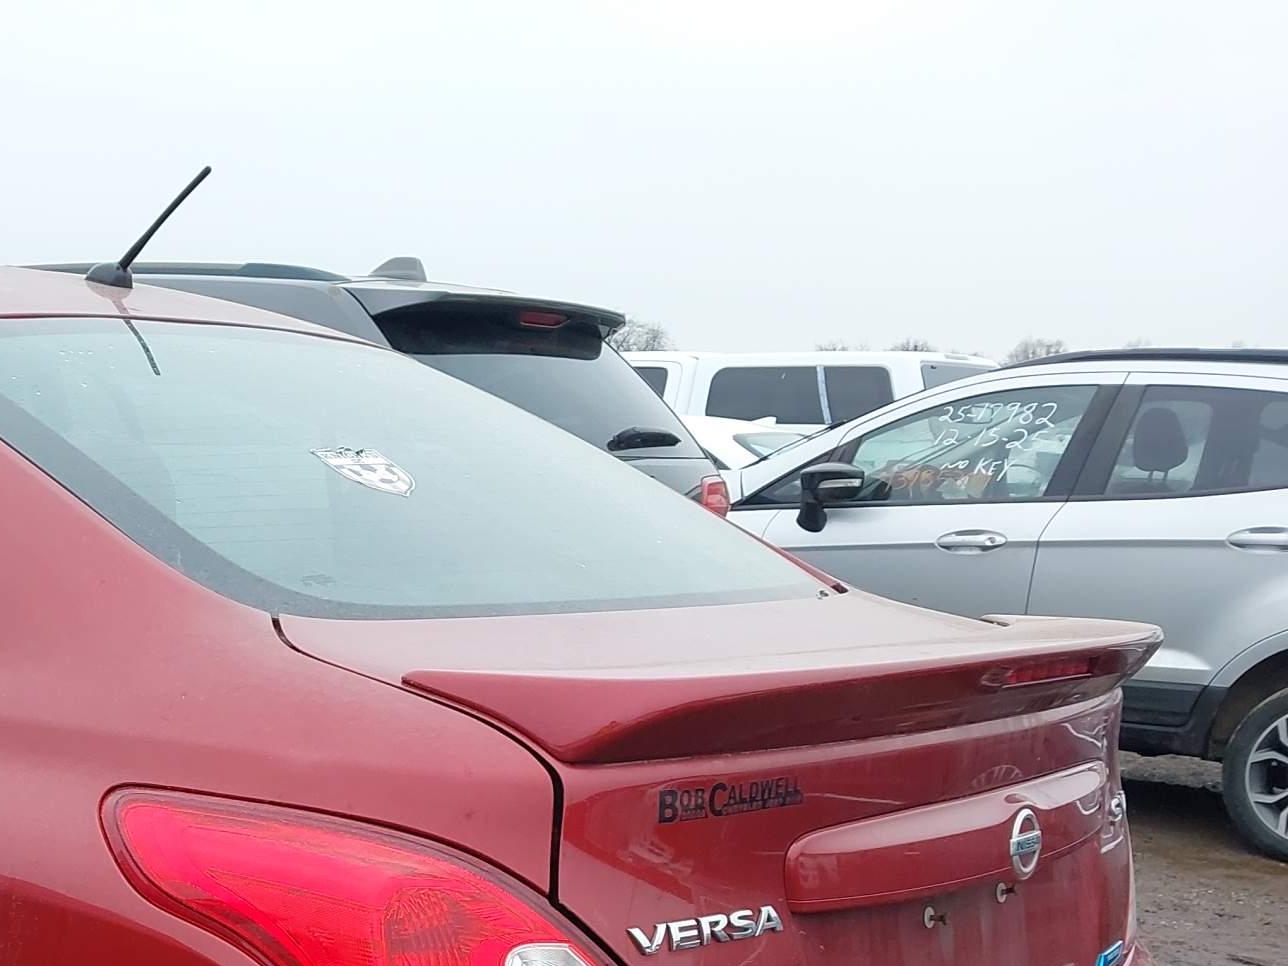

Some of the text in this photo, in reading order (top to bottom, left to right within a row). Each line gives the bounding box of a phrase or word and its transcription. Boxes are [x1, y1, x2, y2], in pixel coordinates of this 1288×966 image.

[973, 456, 1018, 482] KEY
[657, 787, 706, 824] BOB
[709, 777, 801, 816] CALDWELL
[626, 905, 784, 956] VERSA
